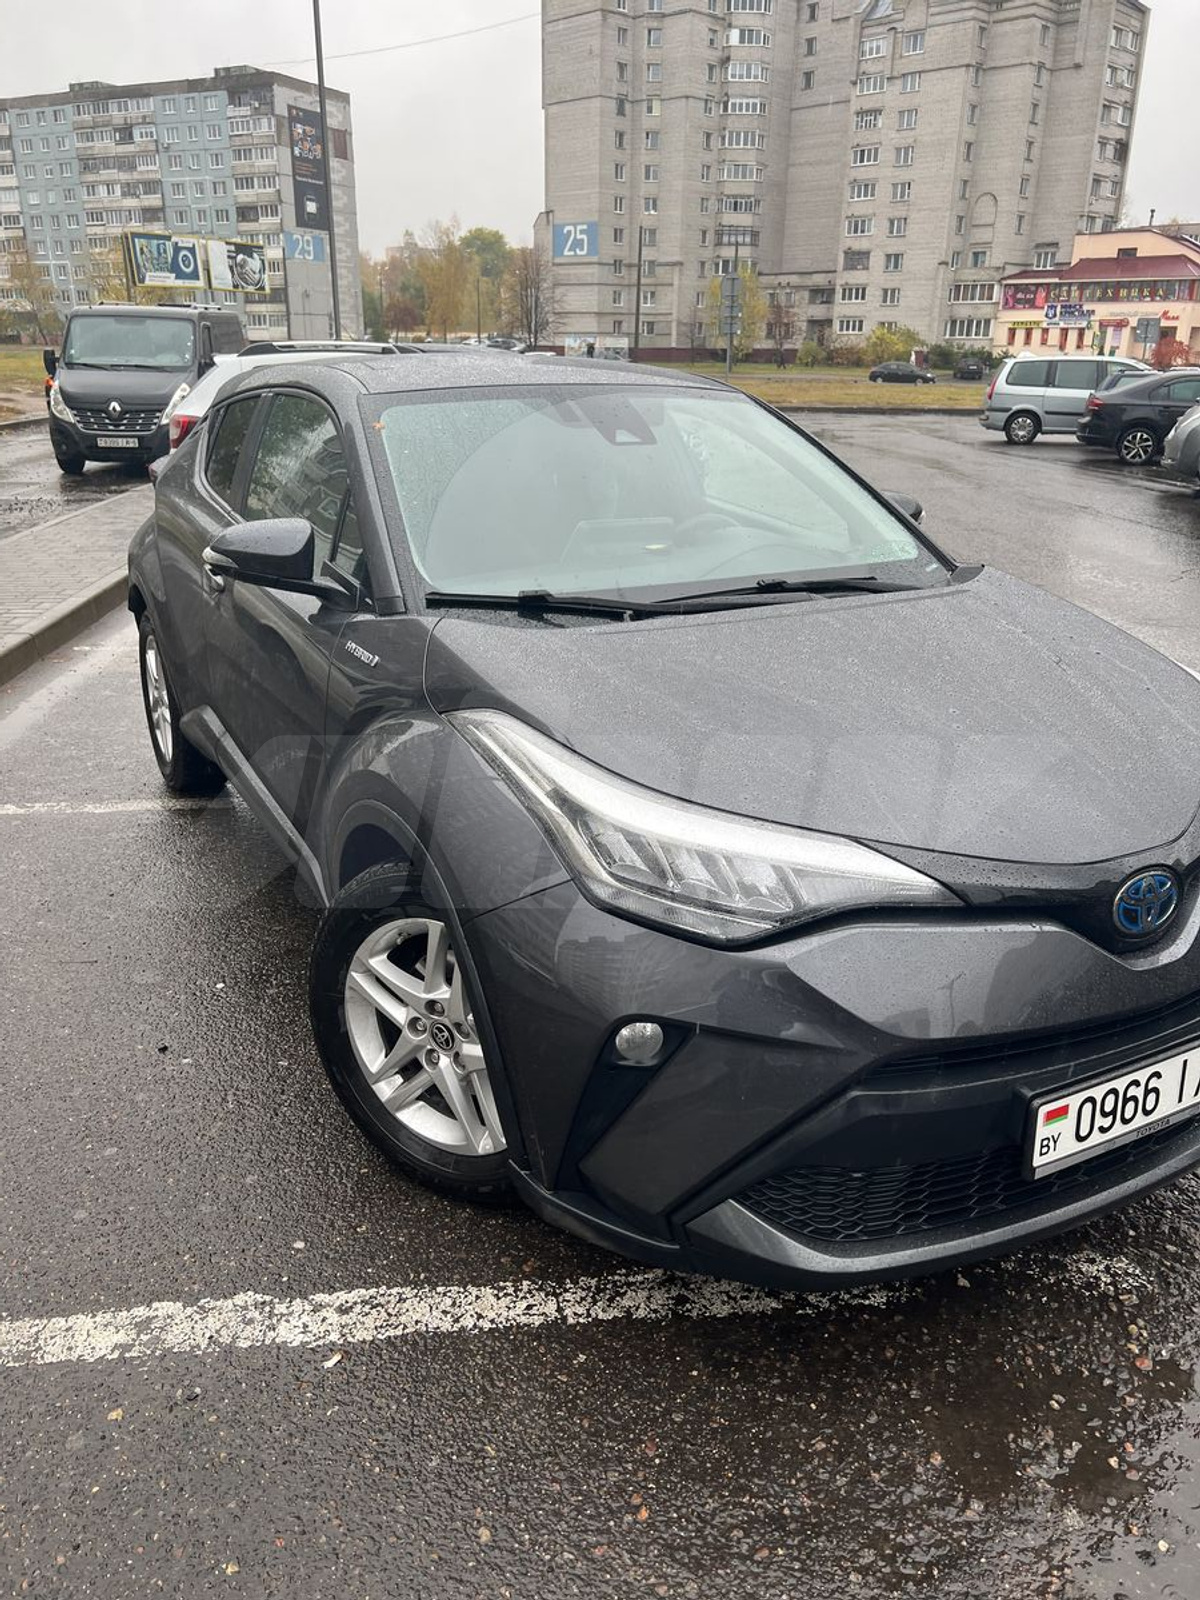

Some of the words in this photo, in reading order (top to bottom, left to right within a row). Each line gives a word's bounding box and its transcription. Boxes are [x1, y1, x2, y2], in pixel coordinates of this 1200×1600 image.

[293, 234, 314, 260] 29
[563, 224, 588, 256] 25
[1074, 1070, 1163, 1143] 0966
[1135, 1118, 1172, 1139] TOYOTA
[1039, 1132, 1061, 1157] BY
